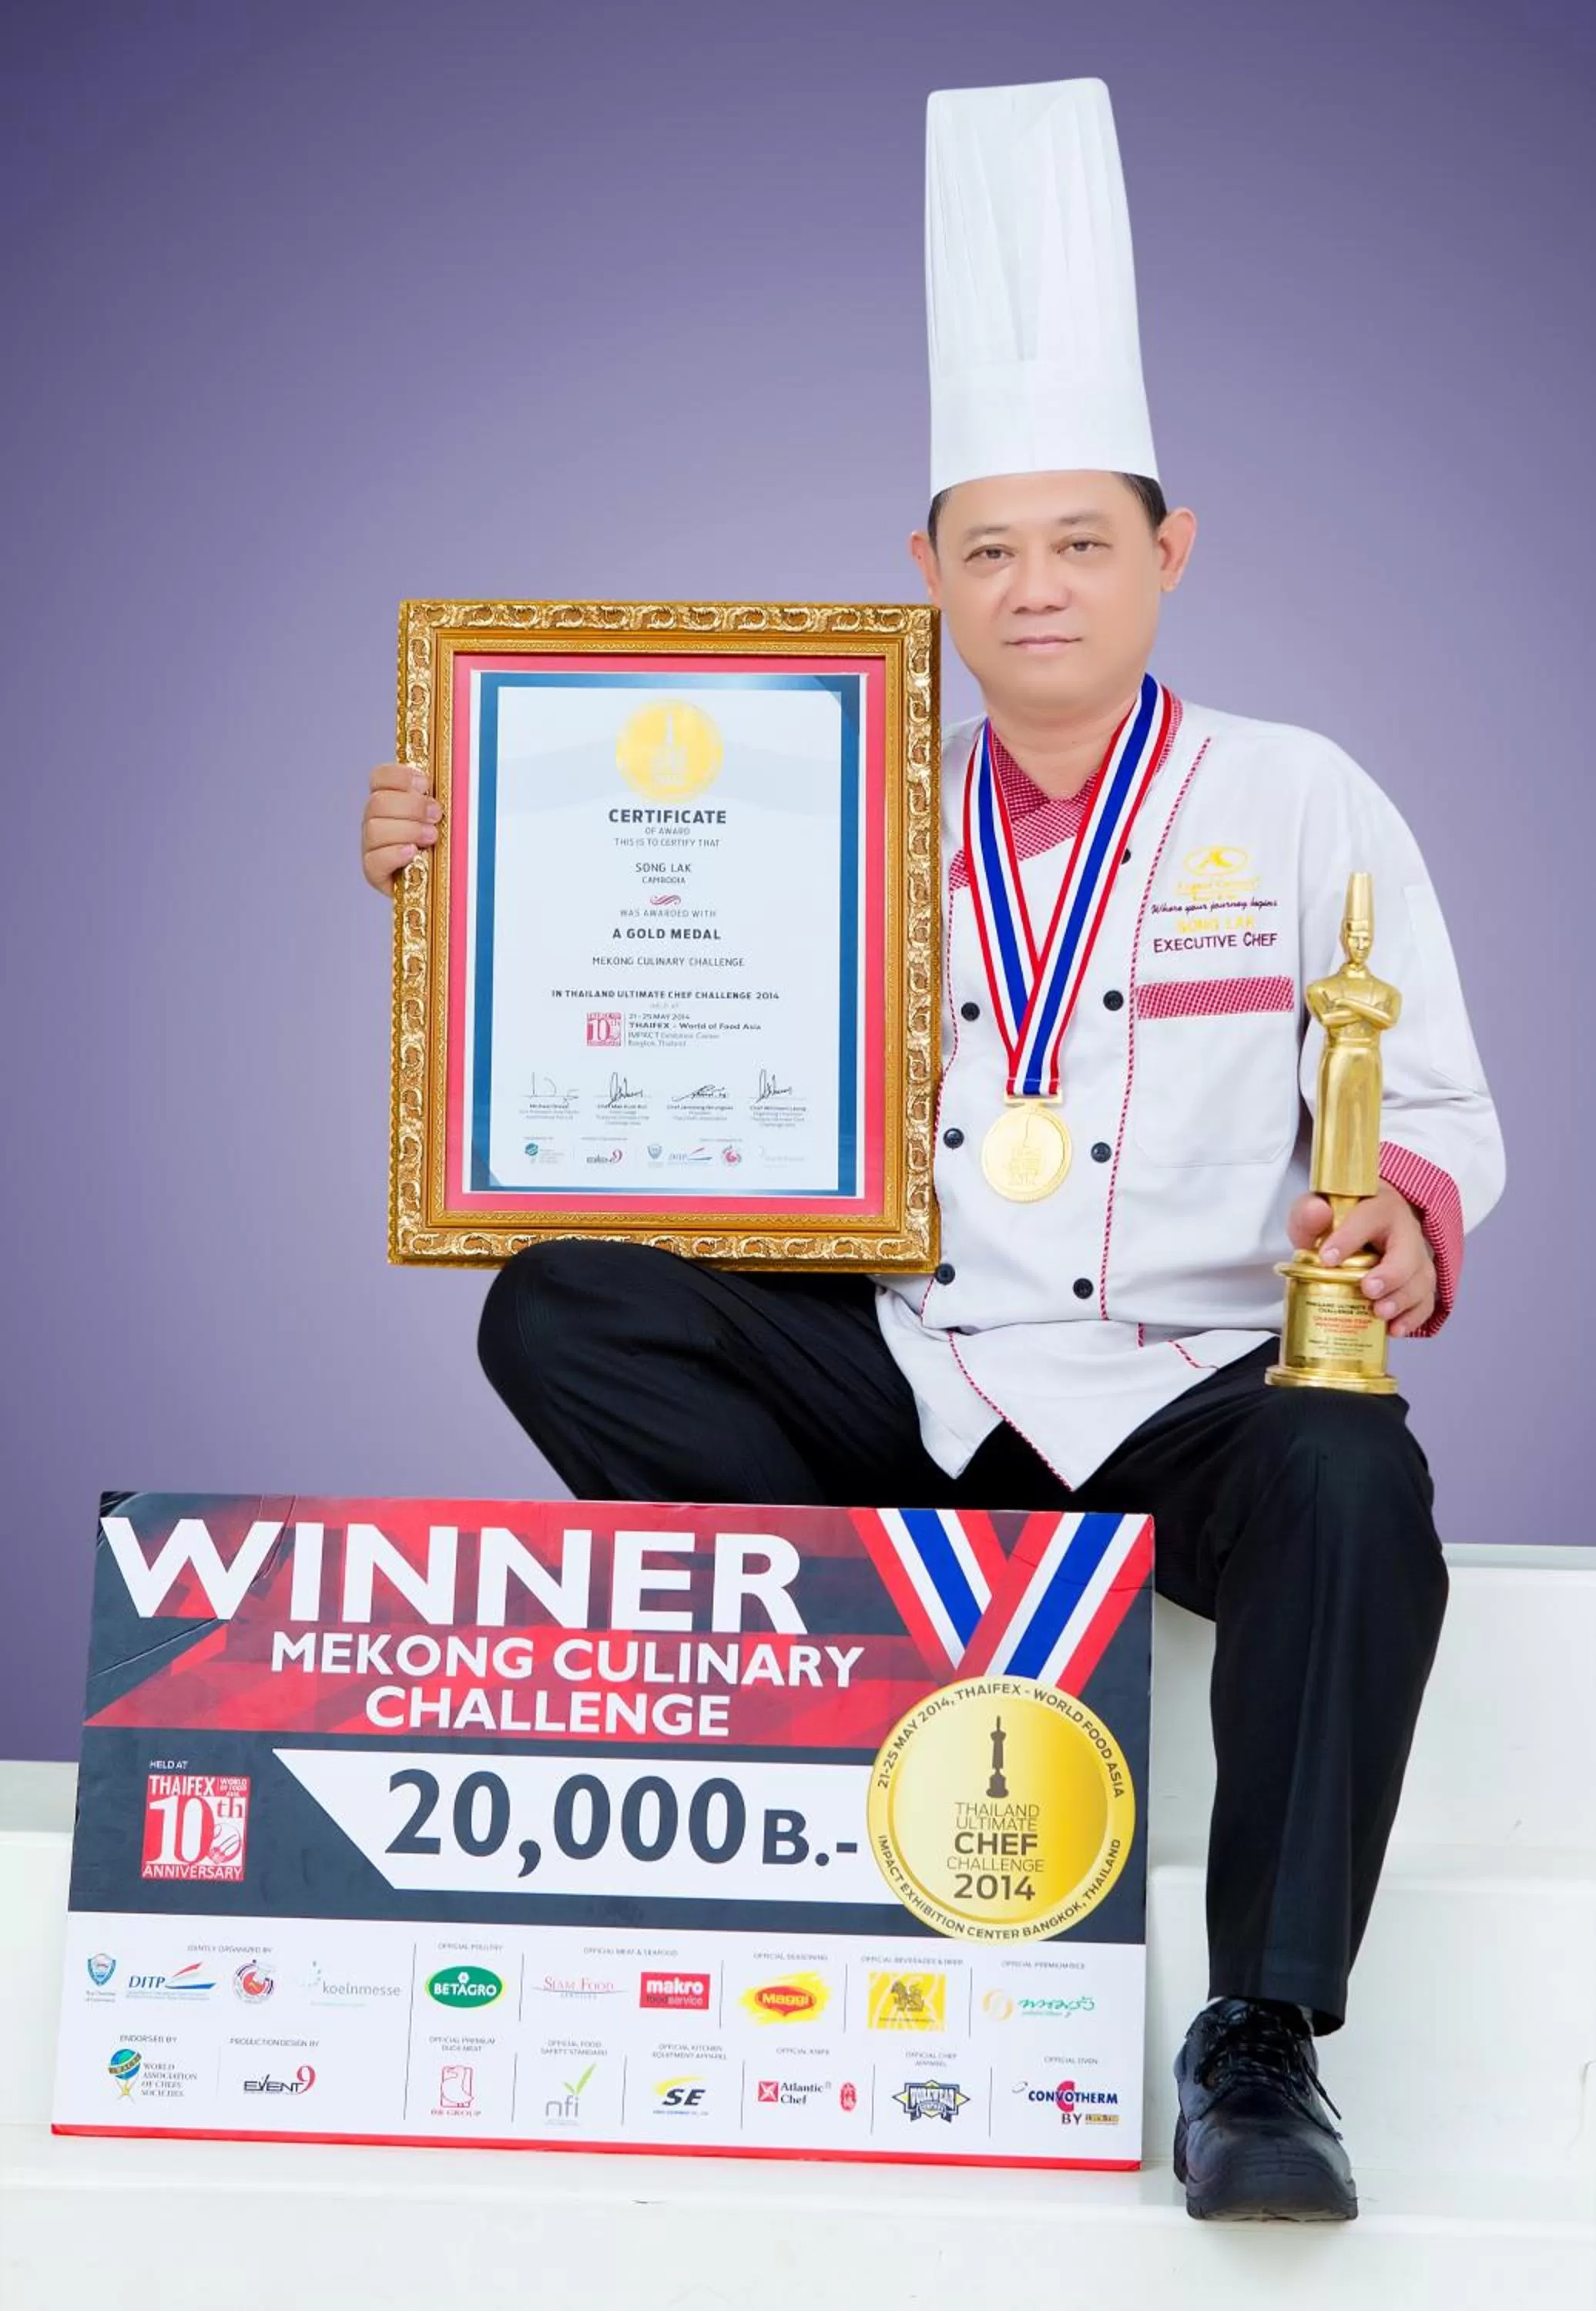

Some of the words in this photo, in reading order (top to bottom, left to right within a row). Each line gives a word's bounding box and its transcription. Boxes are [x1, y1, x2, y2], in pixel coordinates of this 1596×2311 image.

[609, 809, 726, 823] CERTIFICATE
[615, 837, 634, 847] THIS
[648, 838, 659, 847] TO
[660, 838, 695, 847] CERTIFY
[699, 839, 719, 847] THAT
[635, 863, 666, 872] SONG
[671, 863, 692, 873] LAK
[612, 928, 622, 939] A
[626, 928, 666, 939] GOLD
[671, 929, 721, 940] MEDAL
[1153, 934, 1237, 953] EXECUTIVE
[1242, 931, 1278, 947] CHEF
[592, 957, 633, 965] MEKONG
[637, 957, 685, 966] CULINARY
[689, 958, 745, 967] CHALLENGE
[100, 1517, 808, 1635] WINNER
[271, 1632, 533, 1679] MEKONG
[554, 1638, 864, 1688] CULINARY
[365, 1685, 730, 1736] CHALLENGE
[877, 1749, 899, 1789] 21-25
[894, 1719, 919, 1751] MAY
[917, 1697, 955, 1723] 2014,
[954, 1683, 1021, 1701] THAIFEX
[1034, 1688, 1084, 1722] WORLD
[1081, 1721, 1113, 1759] FOOD
[1106, 1762, 1125, 1799] ASIA
[149, 1760, 175, 1769] HELD
[176, 1760, 188, 1769] AT
[149, 1775, 216, 1796] THAIFEX
[954, 1802, 1040, 1819] THAILAND
[384, 1769, 746, 1878] 20,000
[955, 1817, 1038, 1832] ULTIMATE
[954, 1832, 1038, 1857] CHEF
[142, 1865, 243, 1880] ANNIVERSARY
[947, 1857, 1045, 1873] CHALLENGE
[878, 1835, 904, 1883] IMPACT
[900, 1882, 965, 1934] EXHIBITION
[967, 1927, 1019, 1940] CENTER
[1022, 1900, 1087, 1937] BANGKOK,
[1082, 1839, 1121, 1900] THAILAND
[954, 1873, 1036, 1901] 2014
[129, 1976, 166, 1989] DITP
[323, 1981, 401, 1996] koelnmesse
[434, 1982, 498, 1997] BETAGRO
[646, 1977, 704, 1995] makro
[662, 2088, 706, 2106] SE
[780, 2095, 807, 2105] Chef
[1028, 2090, 1118, 2105] CONVOTHERM
[545, 2095, 579, 2118] nfi
[1061, 2113, 1083, 2125] BY
